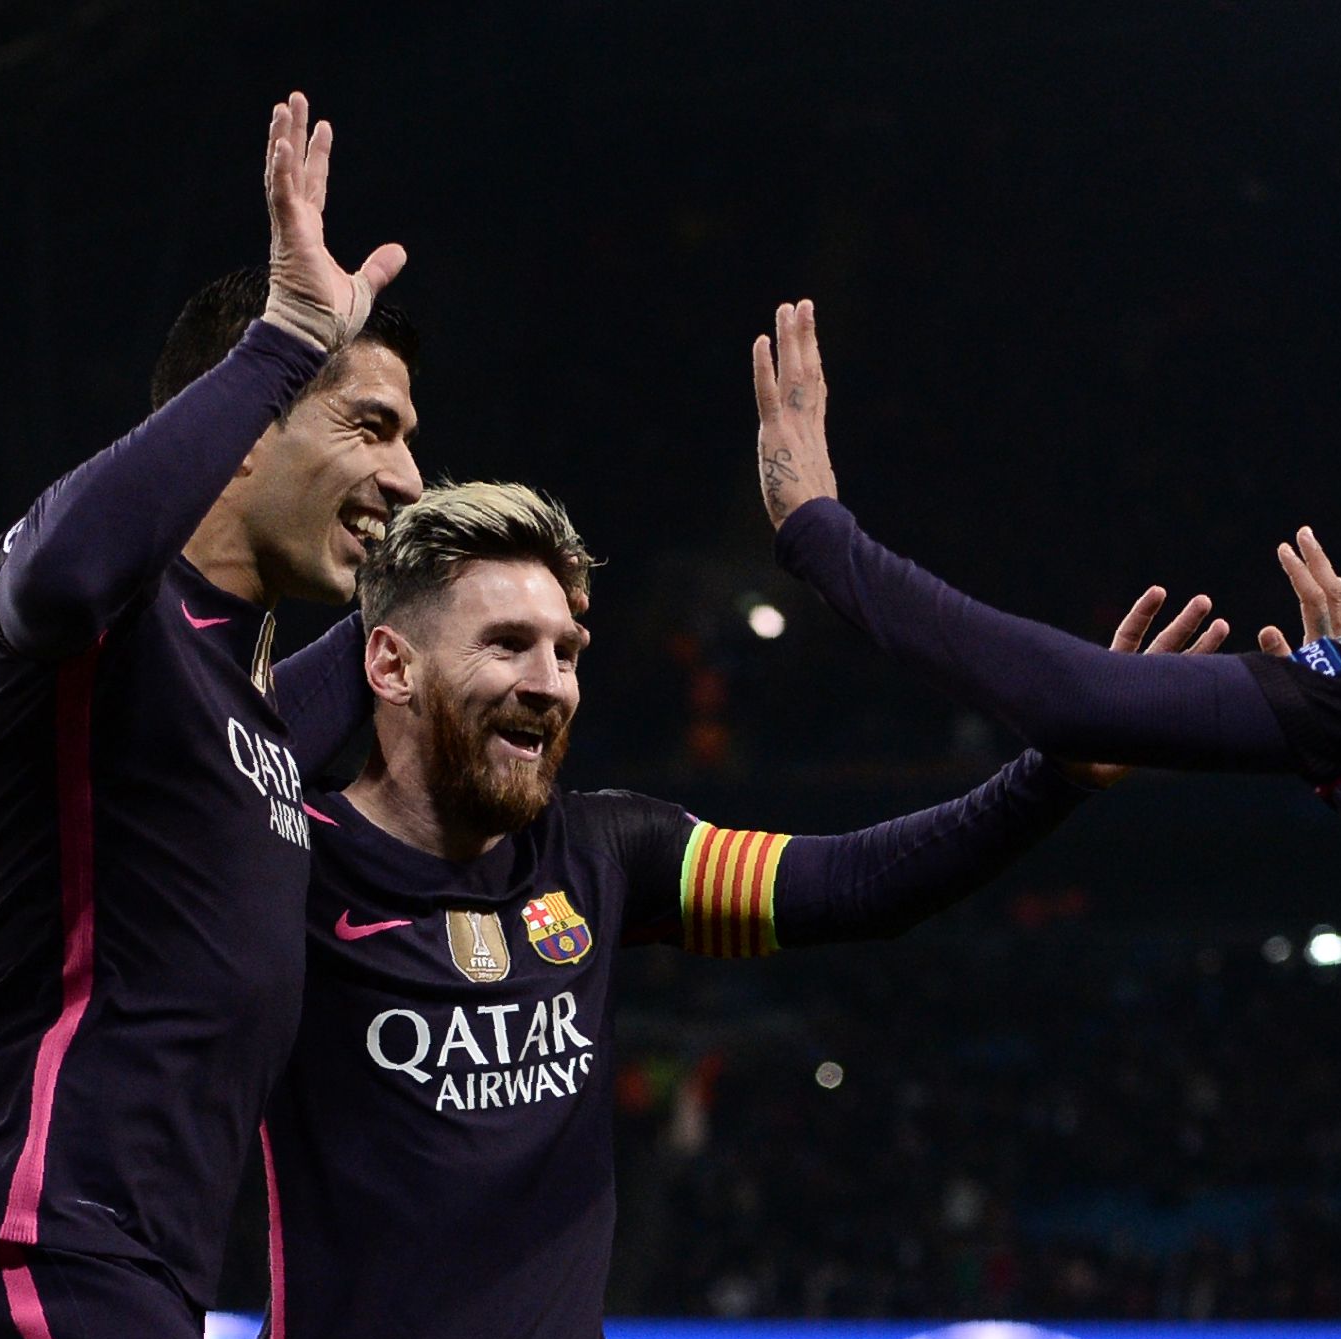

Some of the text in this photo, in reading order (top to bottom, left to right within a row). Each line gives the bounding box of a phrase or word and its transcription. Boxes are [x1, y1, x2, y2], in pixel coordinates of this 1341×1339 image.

[1299, 641, 1336, 677] PECT
[227, 717, 304, 803] QATA
[270, 796, 310, 851] AIRW
[470, 956, 497, 969] FIFA
[367, 991, 594, 1084] QATAR
[435, 1053, 594, 1112] AIRWAYS
